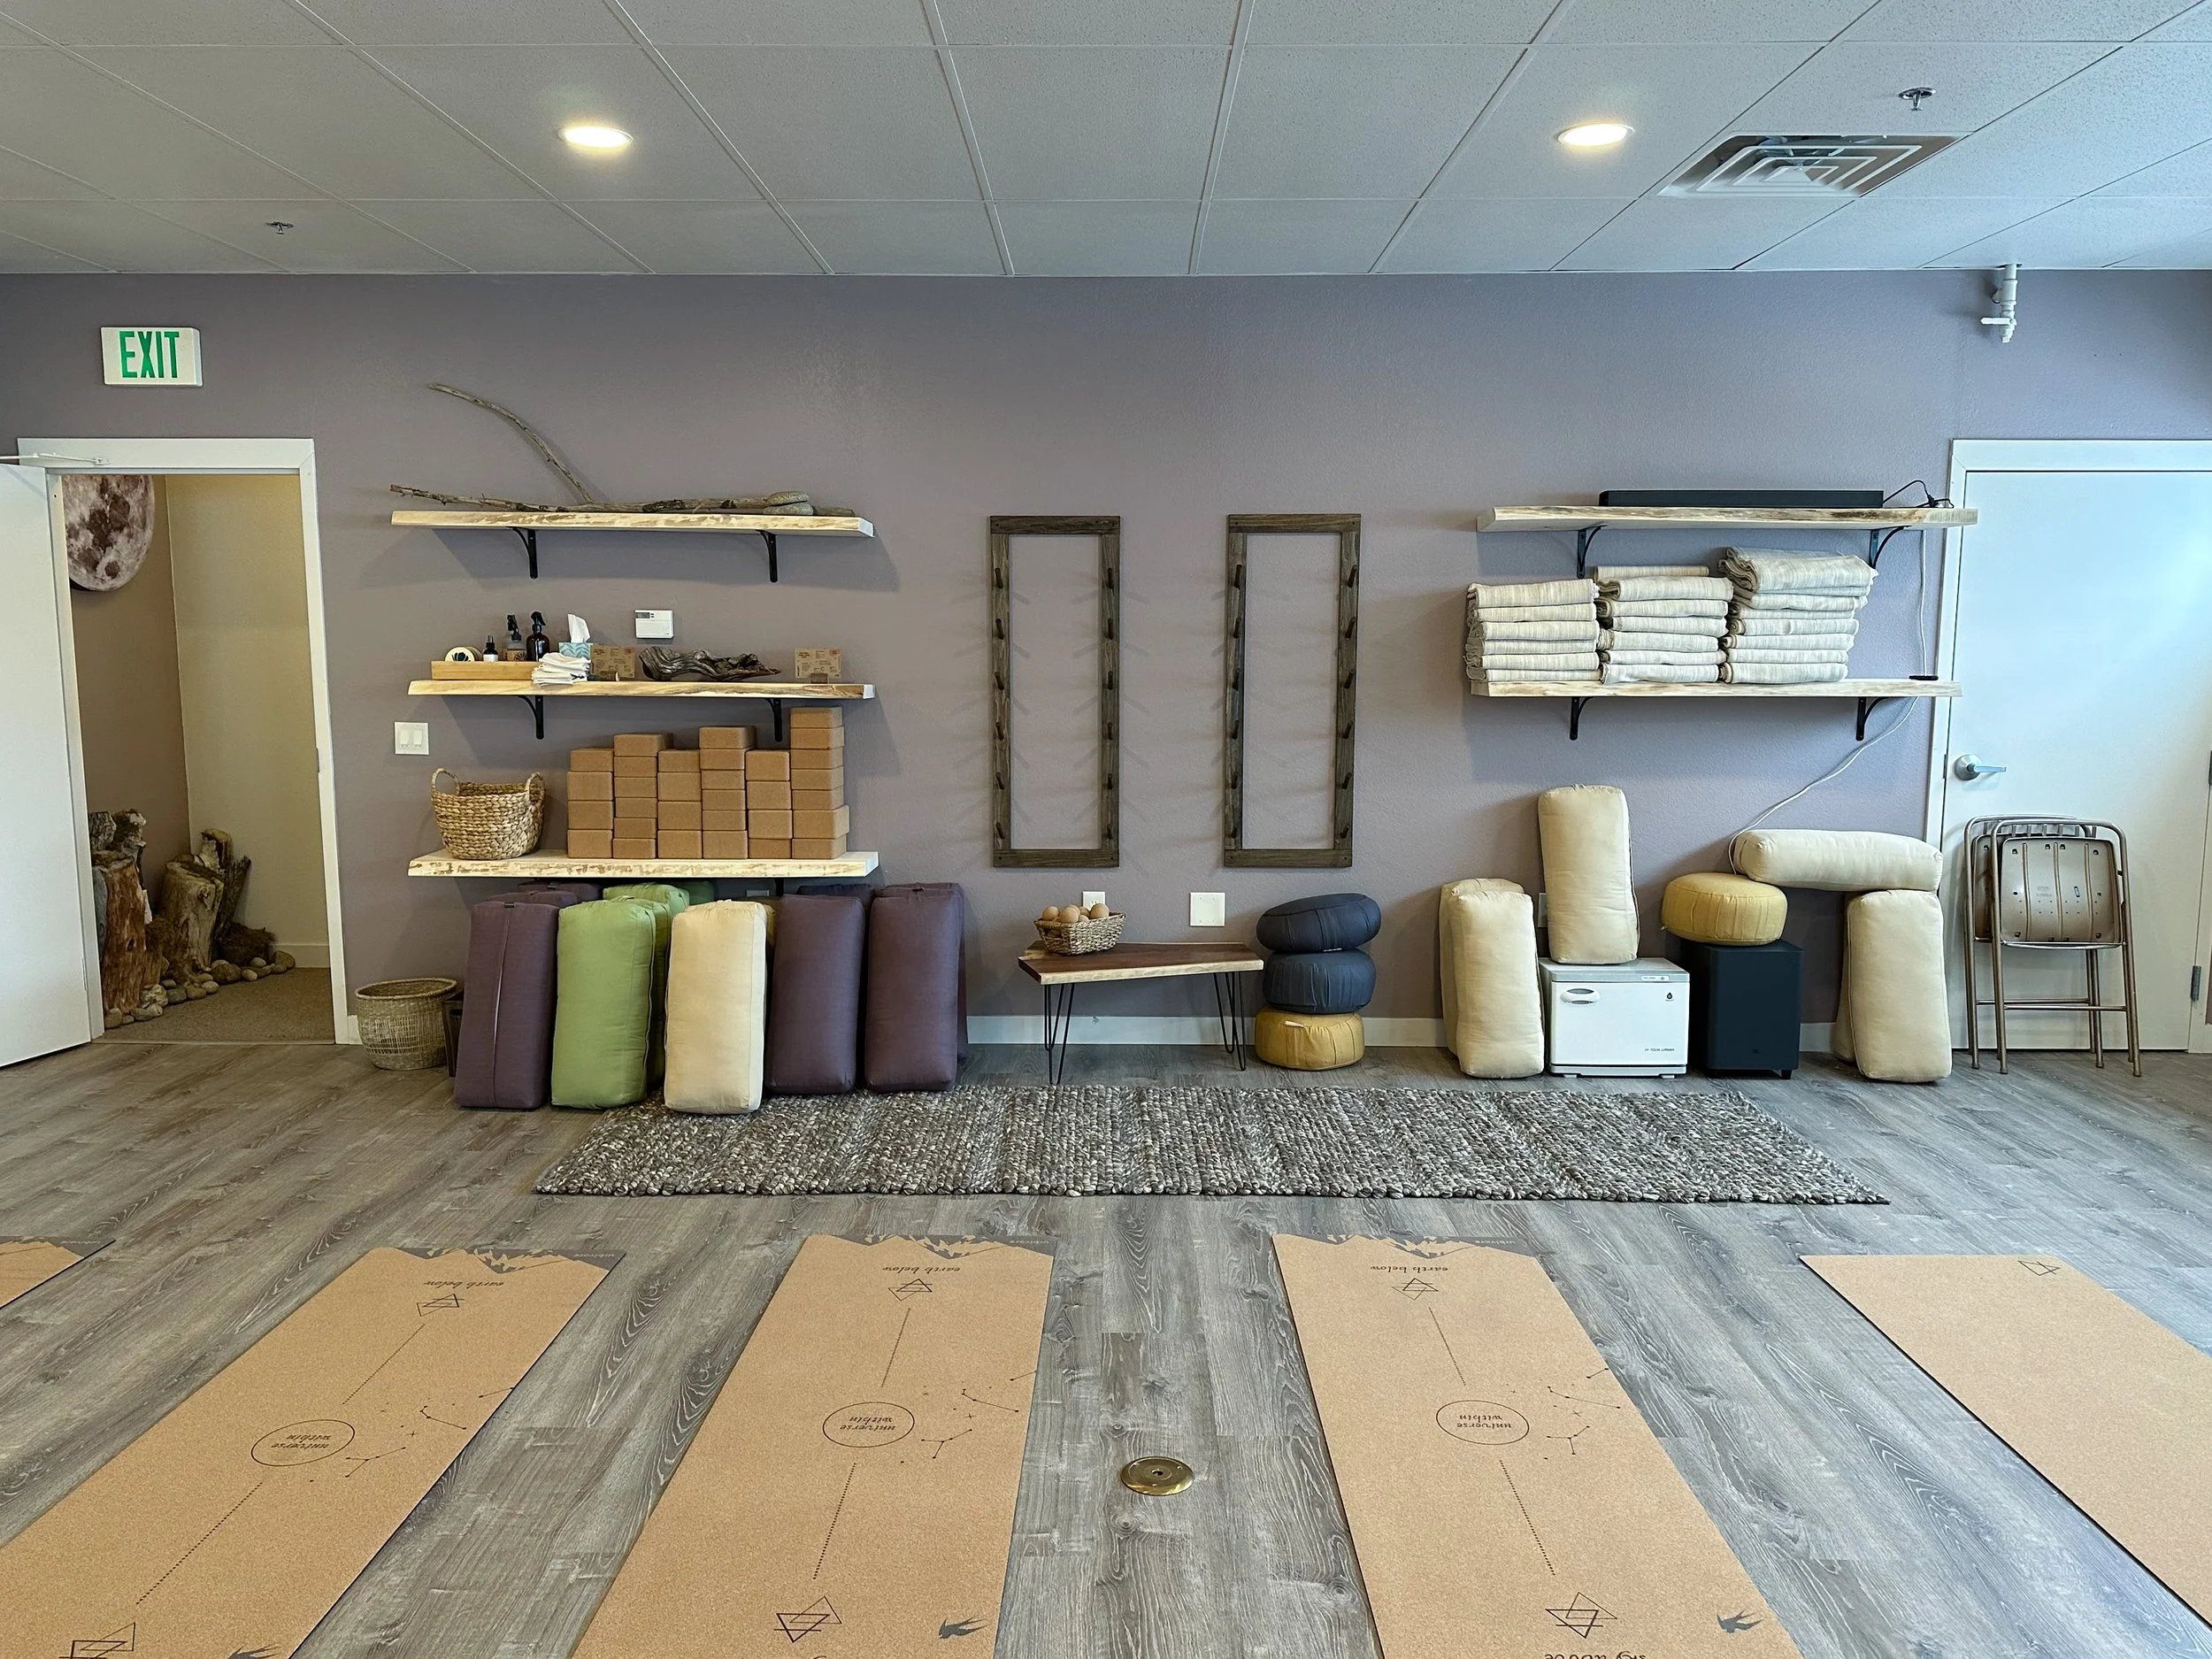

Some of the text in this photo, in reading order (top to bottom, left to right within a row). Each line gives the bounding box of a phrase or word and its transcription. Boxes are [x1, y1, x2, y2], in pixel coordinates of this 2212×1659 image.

[119, 331, 180, 378] EXIT
[1412, 1265, 1448, 1274] earth
[423, 1280, 463, 1289] below
[849, 1417, 893, 1425] within
